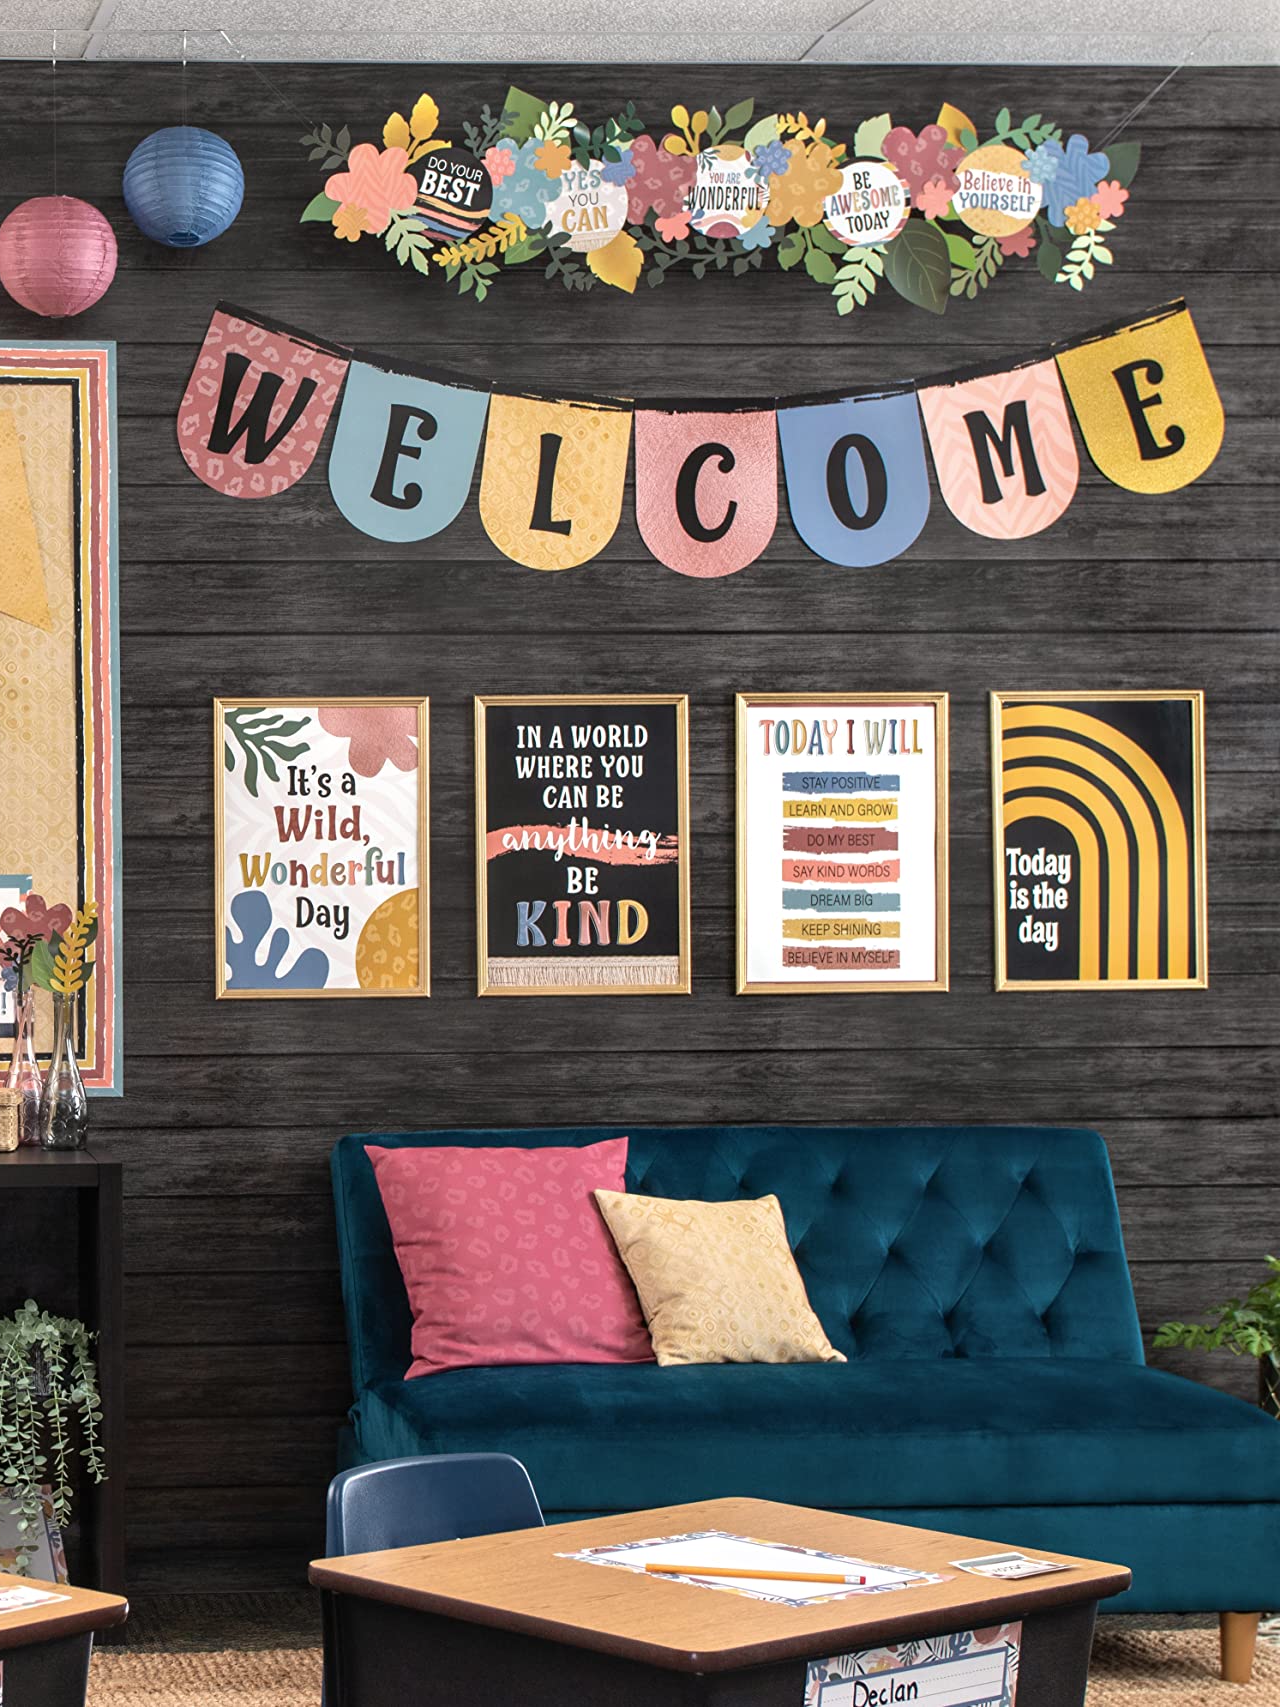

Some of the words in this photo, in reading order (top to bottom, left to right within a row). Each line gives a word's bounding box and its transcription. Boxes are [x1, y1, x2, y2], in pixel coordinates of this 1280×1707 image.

[426, 156, 448, 172] DO
[450, 162, 484, 183] YOUR
[562, 169, 601, 191] YES
[708, 172, 725, 185] YOU
[725, 172, 742, 185] ARE
[852, 170, 871, 191] BE
[963, 169, 1014, 193] Believe
[1017, 176, 1032, 195] in
[419, 169, 481, 207] BEST
[568, 192, 599, 208] YOU
[687, 186, 761, 211] WONDERFUL
[830, 184, 901, 217] AWESOME
[959, 191, 1036, 213] YOURSELF
[561, 205, 609, 233] CAN
[845, 210, 890, 235] TODAY
[206, 352, 1186, 544] WELCOME
[516, 725, 542, 749] IN
[549, 725, 565, 749] A
[572, 724, 649, 749] WORLD
[758, 718, 839, 756] TODAY
[846, 719, 856, 755] I
[863, 718, 924, 755] WILL
[515, 754, 593, 779] WHERE
[600, 754, 645, 779] YOU
[287, 765, 332, 797] It's
[341, 775, 357, 797] a
[801, 776, 829, 790] STAY
[831, 776, 881, 790] POSITIVE
[542, 784, 589, 809] CAN
[596, 784, 624, 809] BE
[788, 803, 827, 817] LEARN
[829, 803, 855, 817] AND
[857, 803, 893, 817] GROW
[273, 804, 371, 847] Wild,
[501, 816, 662, 862] anything
[807, 833, 825, 847] DO
[827, 833, 845, 847] MY
[847, 833, 875, 847] BEST
[239, 846, 407, 888] Wonderful
[792, 864, 815, 878] SAY
[817, 864, 844, 878] KIND
[846, 864, 891, 878] WORDS
[1005, 847, 1072, 885] Today
[567, 866, 599, 895] BE
[810, 893, 851, 907] DREAM
[853, 893, 874, 907] BIG
[1009, 882, 1030, 910] is
[1032, 880, 1068, 910] the
[295, 896, 350, 941] Day
[516, 899, 650, 947] KIND
[801, 923, 831, 937] KEEP
[833, 923, 881, 937] SHINING
[1018, 915, 1060, 952] day
[787, 951, 833, 965] BELIEVE
[836, 951, 849, 965] IN
[851, 951, 896, 965] MYSELF
[852, 1678, 918, 1707] Declan
